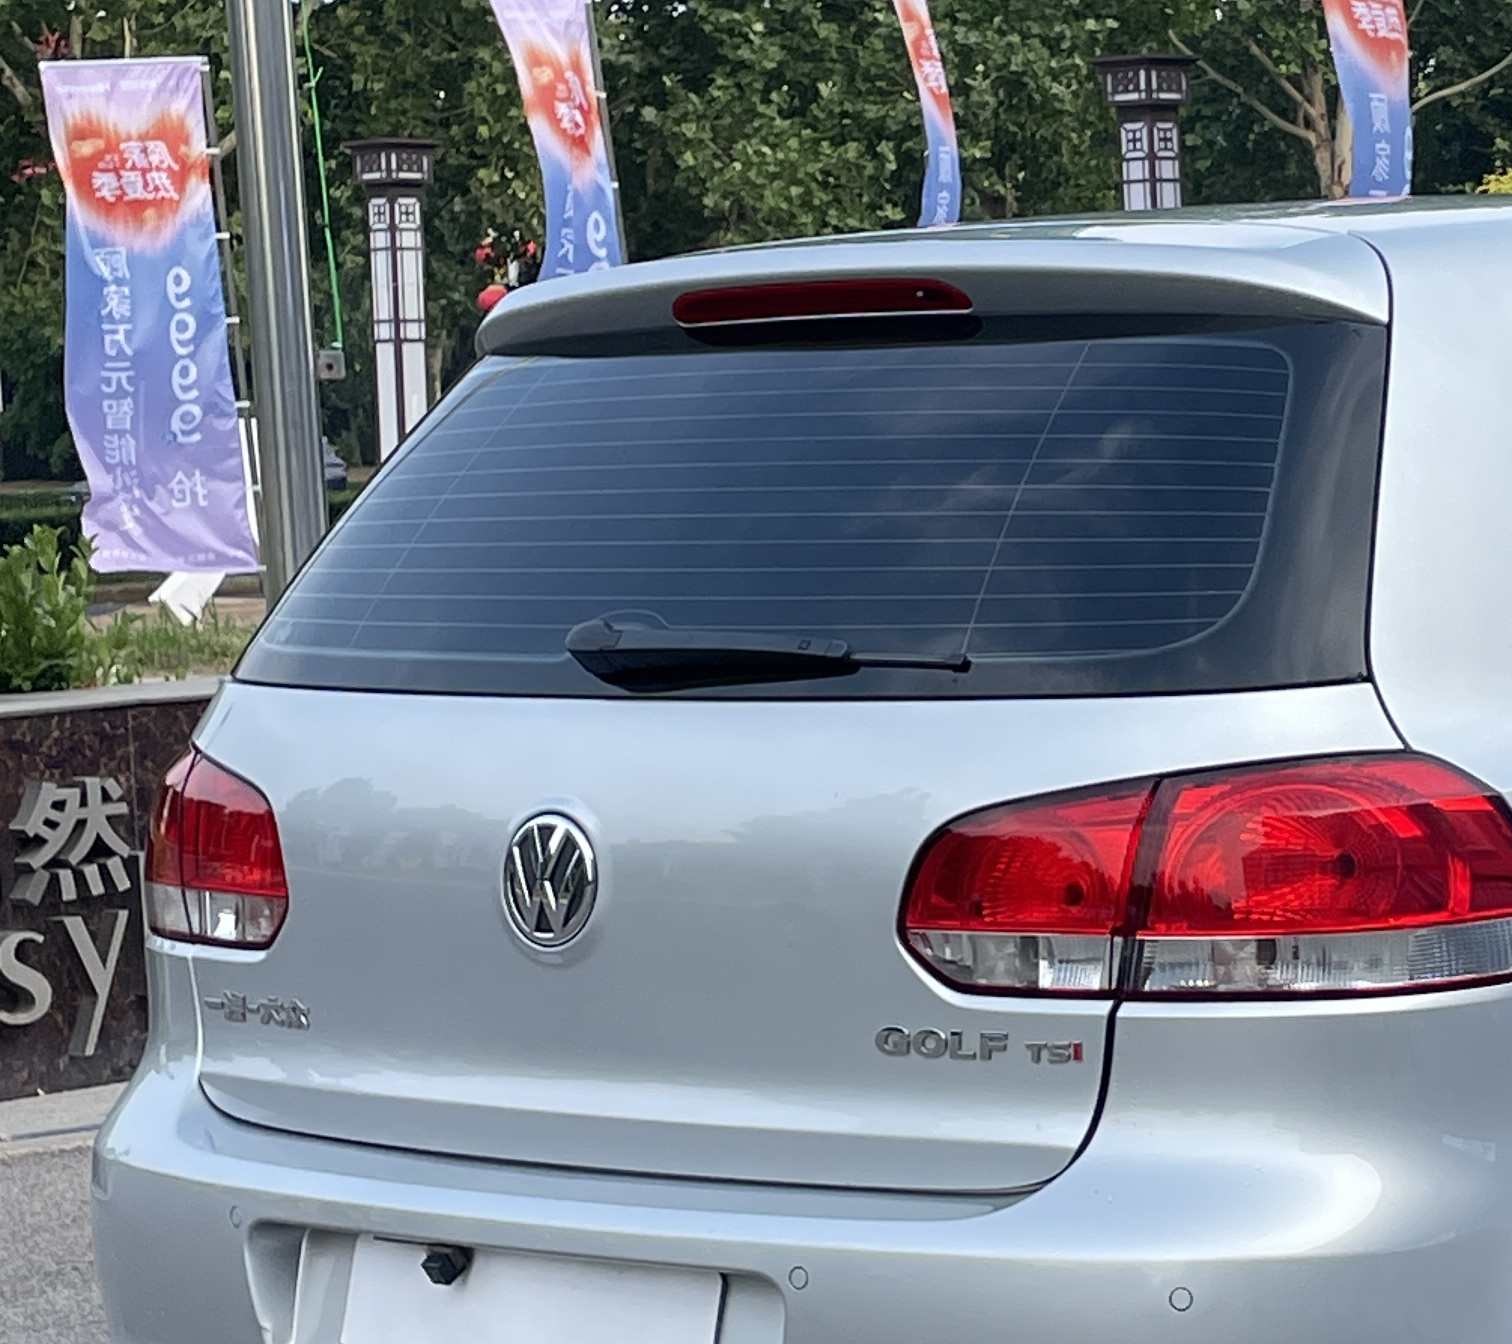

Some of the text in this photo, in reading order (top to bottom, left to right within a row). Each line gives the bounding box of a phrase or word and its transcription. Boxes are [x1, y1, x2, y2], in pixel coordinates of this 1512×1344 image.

[9, 776, 131, 905] 然
[875, 1025, 1083, 1065] GOLF TSI
